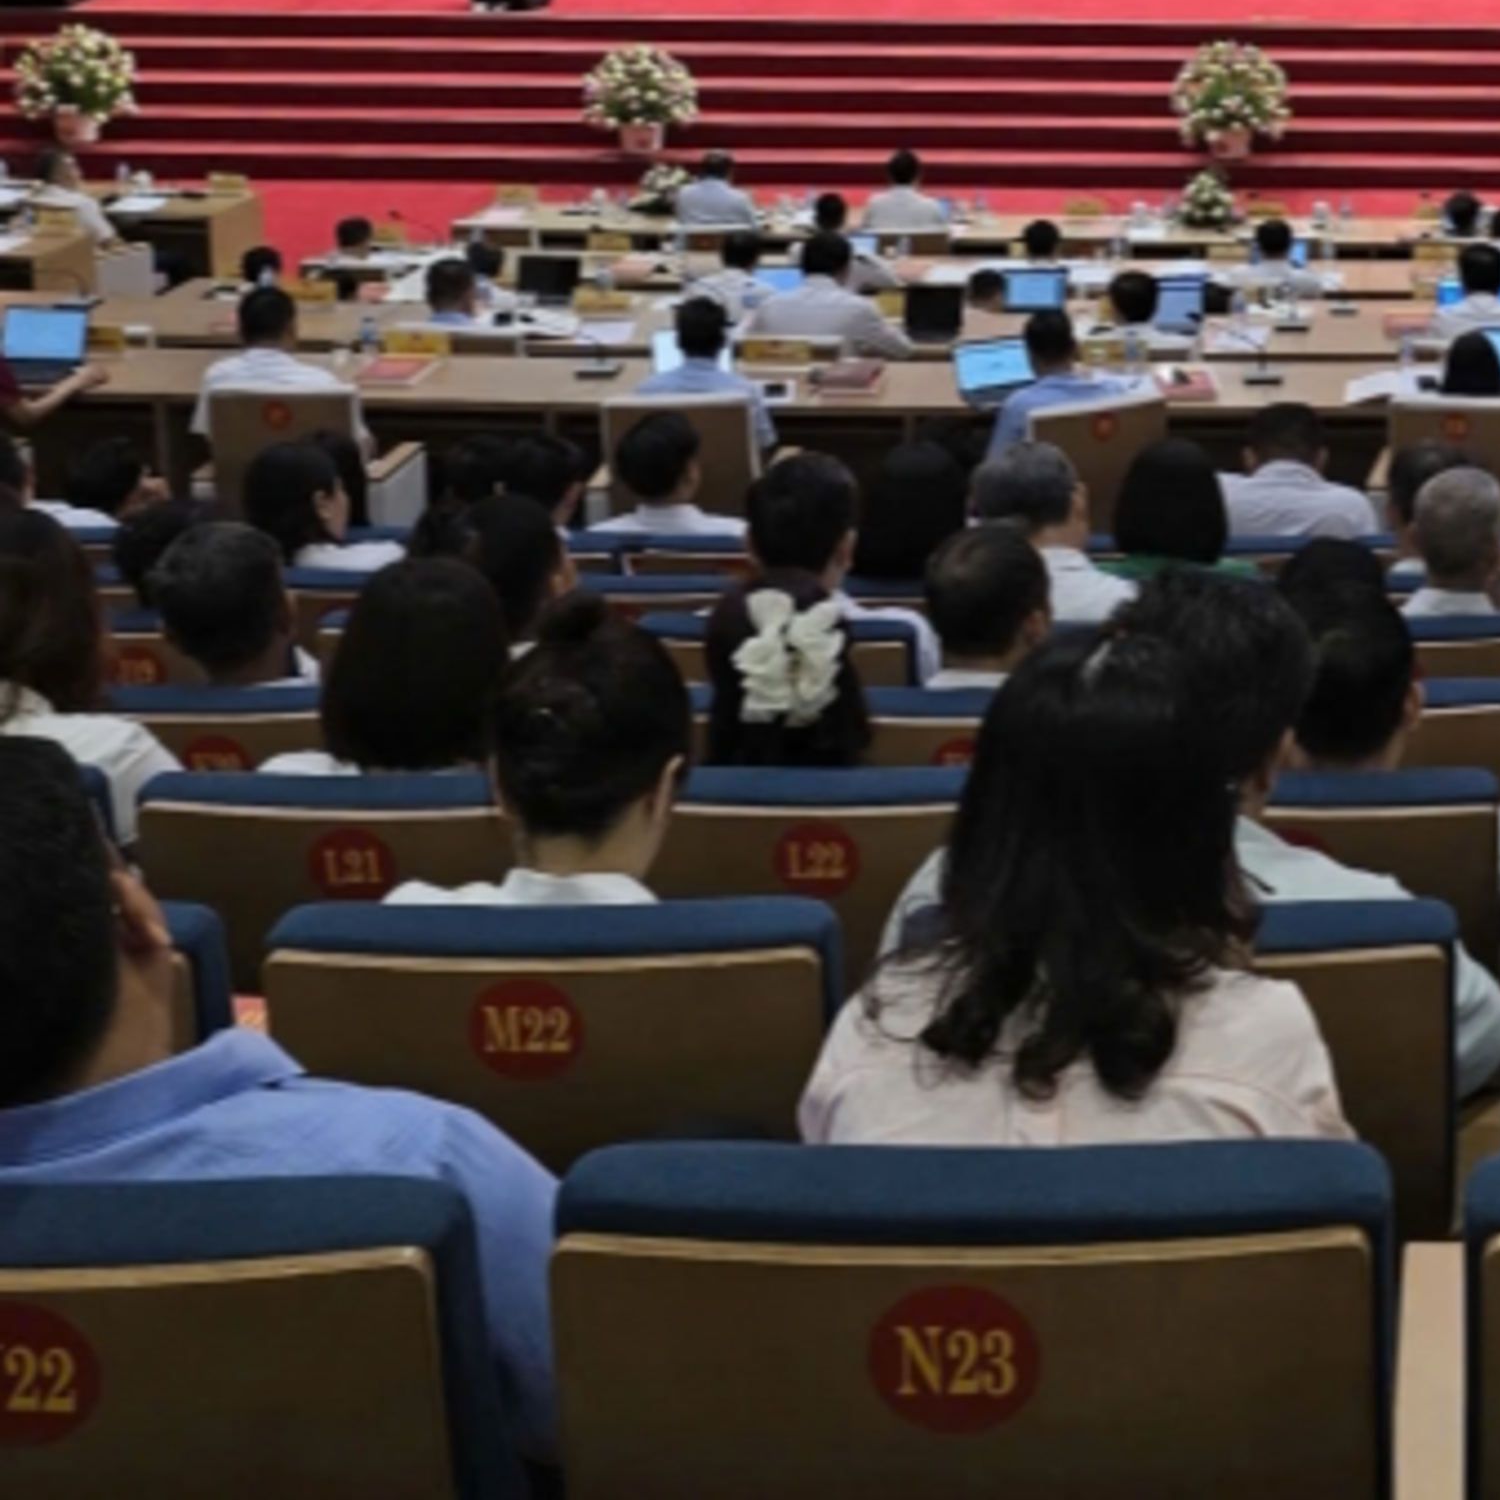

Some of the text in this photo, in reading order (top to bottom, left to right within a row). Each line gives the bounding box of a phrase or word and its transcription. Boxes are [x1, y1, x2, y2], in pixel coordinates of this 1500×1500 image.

[480, 1005, 572, 1052] M22
[0, 1345, 76, 1411] 22
[894, 1326, 1017, 1397] N23
